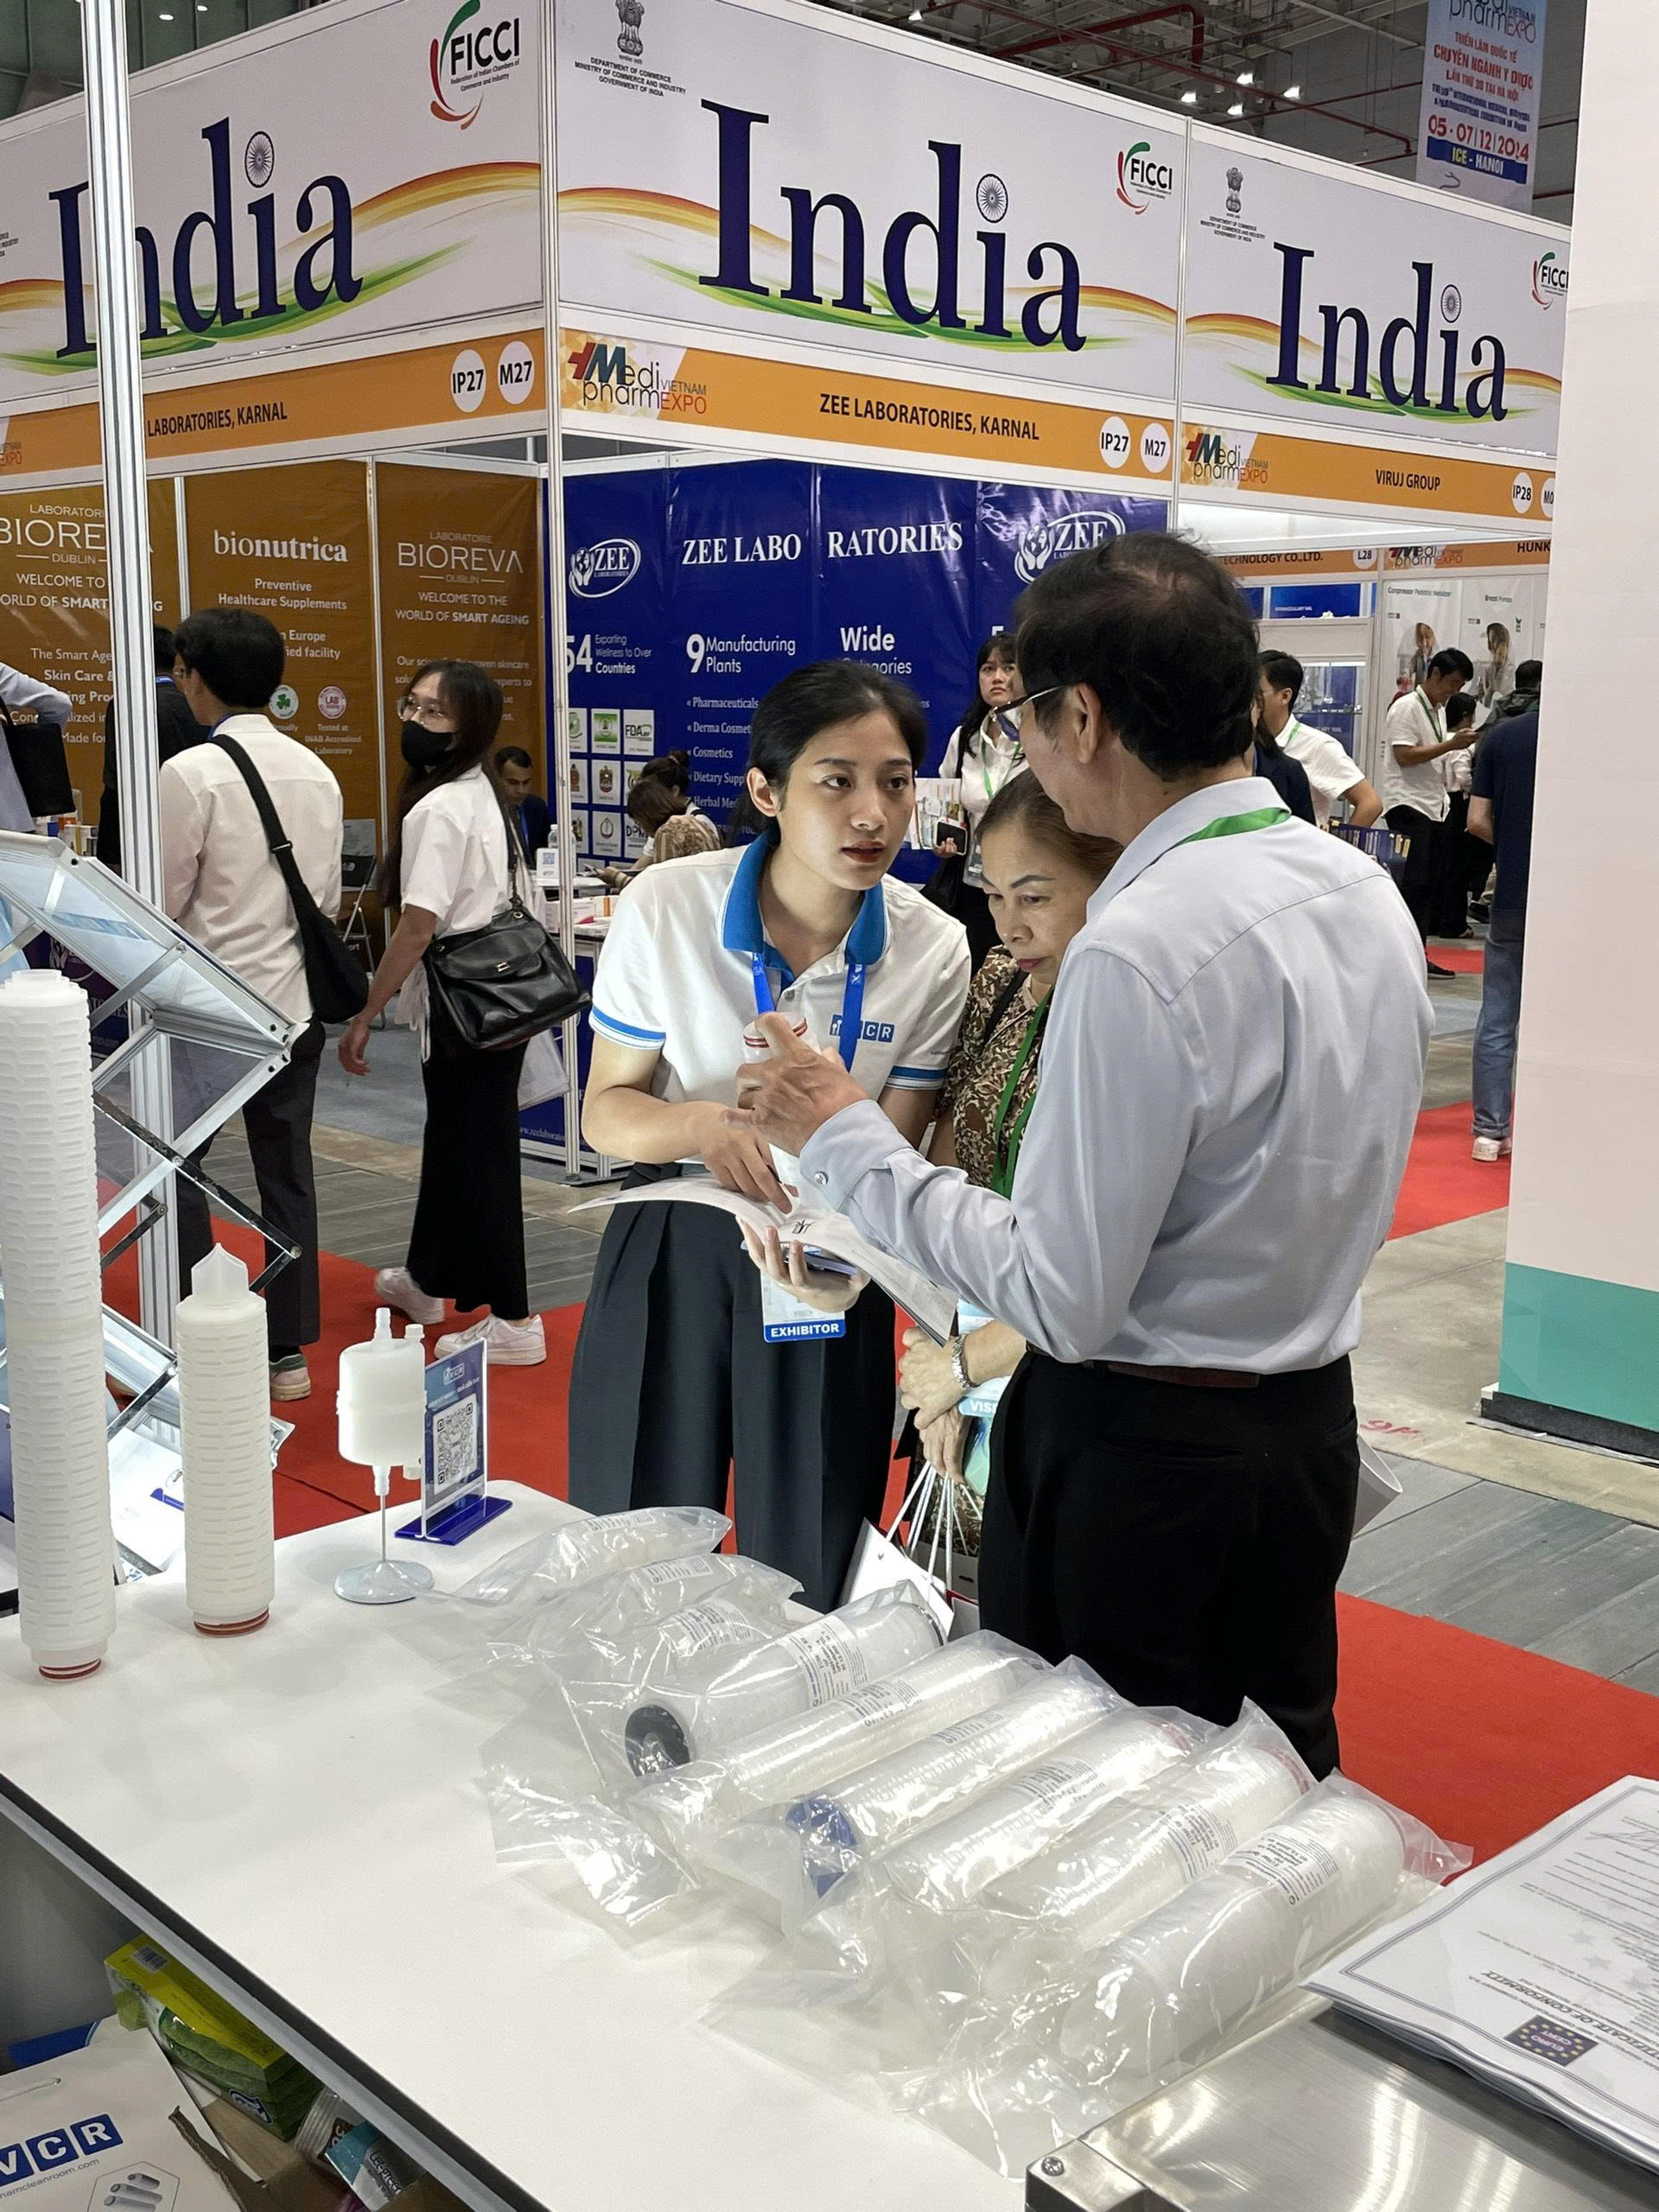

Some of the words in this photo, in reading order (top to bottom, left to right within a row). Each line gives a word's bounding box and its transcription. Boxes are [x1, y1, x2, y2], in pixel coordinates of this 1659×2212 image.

[451, 17, 519, 75] FICCI
[590, 57, 628, 73] DEPARTMENT
[645, 79, 658, 88] AND
[1428, 114, 1446, 137] 05
[1452, 146, 1467, 163] ICE
[1475, 153, 1503, 175] HANOI
[1130, 158, 1173, 189] FICCI
[698, 98, 1087, 352] India
[1541, 265, 1569, 289] FICCI
[1266, 242, 1508, 422] India
[499, 359, 532, 387] M27
[584, 343, 659, 389] Medi
[452, 369, 485, 395] IP27
[660, 378, 706, 395] VIETNAM
[583, 379, 660, 409] pharm
[660, 391, 707, 414] EXPO
[147, 409, 234, 437] LABORATORIES,
[237, 402, 287, 426] KARNAL
[820, 393, 850, 416] ZEE
[854, 398, 976, 435] LABORATORIES,
[981, 415, 1039, 441] KARNAL
[1101, 431, 1129, 454] IP27
[1144, 438, 1166, 458] M27
[1196, 433, 1241, 467] Medi
[1193, 461, 1240, 481] pharm
[1241, 467, 1268, 484] EXPO
[1376, 469, 1404, 487] VIRUJ
[1406, 474, 1440, 491] GROUP
[1513, 484, 1532, 501] IP28
[30, 505, 105, 518] LABORATORI
[0, 517, 106, 550] BIORE
[213, 529, 348, 563] bionutrica
[682, 537, 728, 565] ZEE
[734, 533, 802, 563] LABO
[827, 522, 963, 559] RATORIES
[52, 553, 96, 564] DUBLIN
[594, 547, 630, 571] ZEE
[1357, 550, 1372, 560] L28
[16, 573, 83, 588] WELCOME
[86, 576, 105, 588] TO
[255, 577, 312, 592] Preventive
[446, 574, 480, 584] DUBLIN
[0, 594, 36, 607] ORLD
[40, 596, 58, 607] OF
[61, 597, 109, 609] SMART
[218, 593, 277, 607] Healthcare
[279, 595, 347, 611] Supplements
[418, 592, 469, 604] WELCOME
[471, 594, 486, 604] TO
[488, 594, 508, 606] THE
[395, 609, 433, 621] WORLD
[435, 611, 449, 621] OF
[452, 612, 488, 623] SMART
[491, 614, 530, 625] AGEING
[289, 630, 326, 642] Europe
[840, 625, 895, 652] Wide
[305, 646, 340, 660] facility
[626, 647, 632, 658] to
[634, 647, 652, 658] Over
[686, 633, 705, 673] 9
[706, 634, 796, 656] Manufacturing
[30, 648, 53, 660] The
[55, 648, 88, 660] Smart
[91, 649, 112, 664] Age
[397, 656, 414, 665] Our
[706, 656, 741, 673] Plants
[44, 670, 71, 682] Skin
[74, 671, 104, 682] Care
[595, 662, 636, 674] Countries
[523, 677, 532, 686] to
[692, 696, 759, 709] Pharmaceuticals
[693, 721, 720, 734] Derma
[721, 722, 751, 734] Cosmet
[693, 746, 733, 759] Cosmetics
[693, 772, 722, 785] Dietary
[694, 796, 720, 808] Herbal
[771, 1323, 839, 1338] EXHIBITOR
[1481, 1970, 1570, 2014] CONFORMITY
[1571, 2012, 1593, 2024] OF
[1531, 2035, 1565, 2051] EURO
[1541, 2030, 1572, 2045] CERT
[1592, 2023, 1659, 2060] TIFICATE
[0, 2122, 111, 2176] VCR
[0, 2158, 100, 2199] namcleanroom.com
